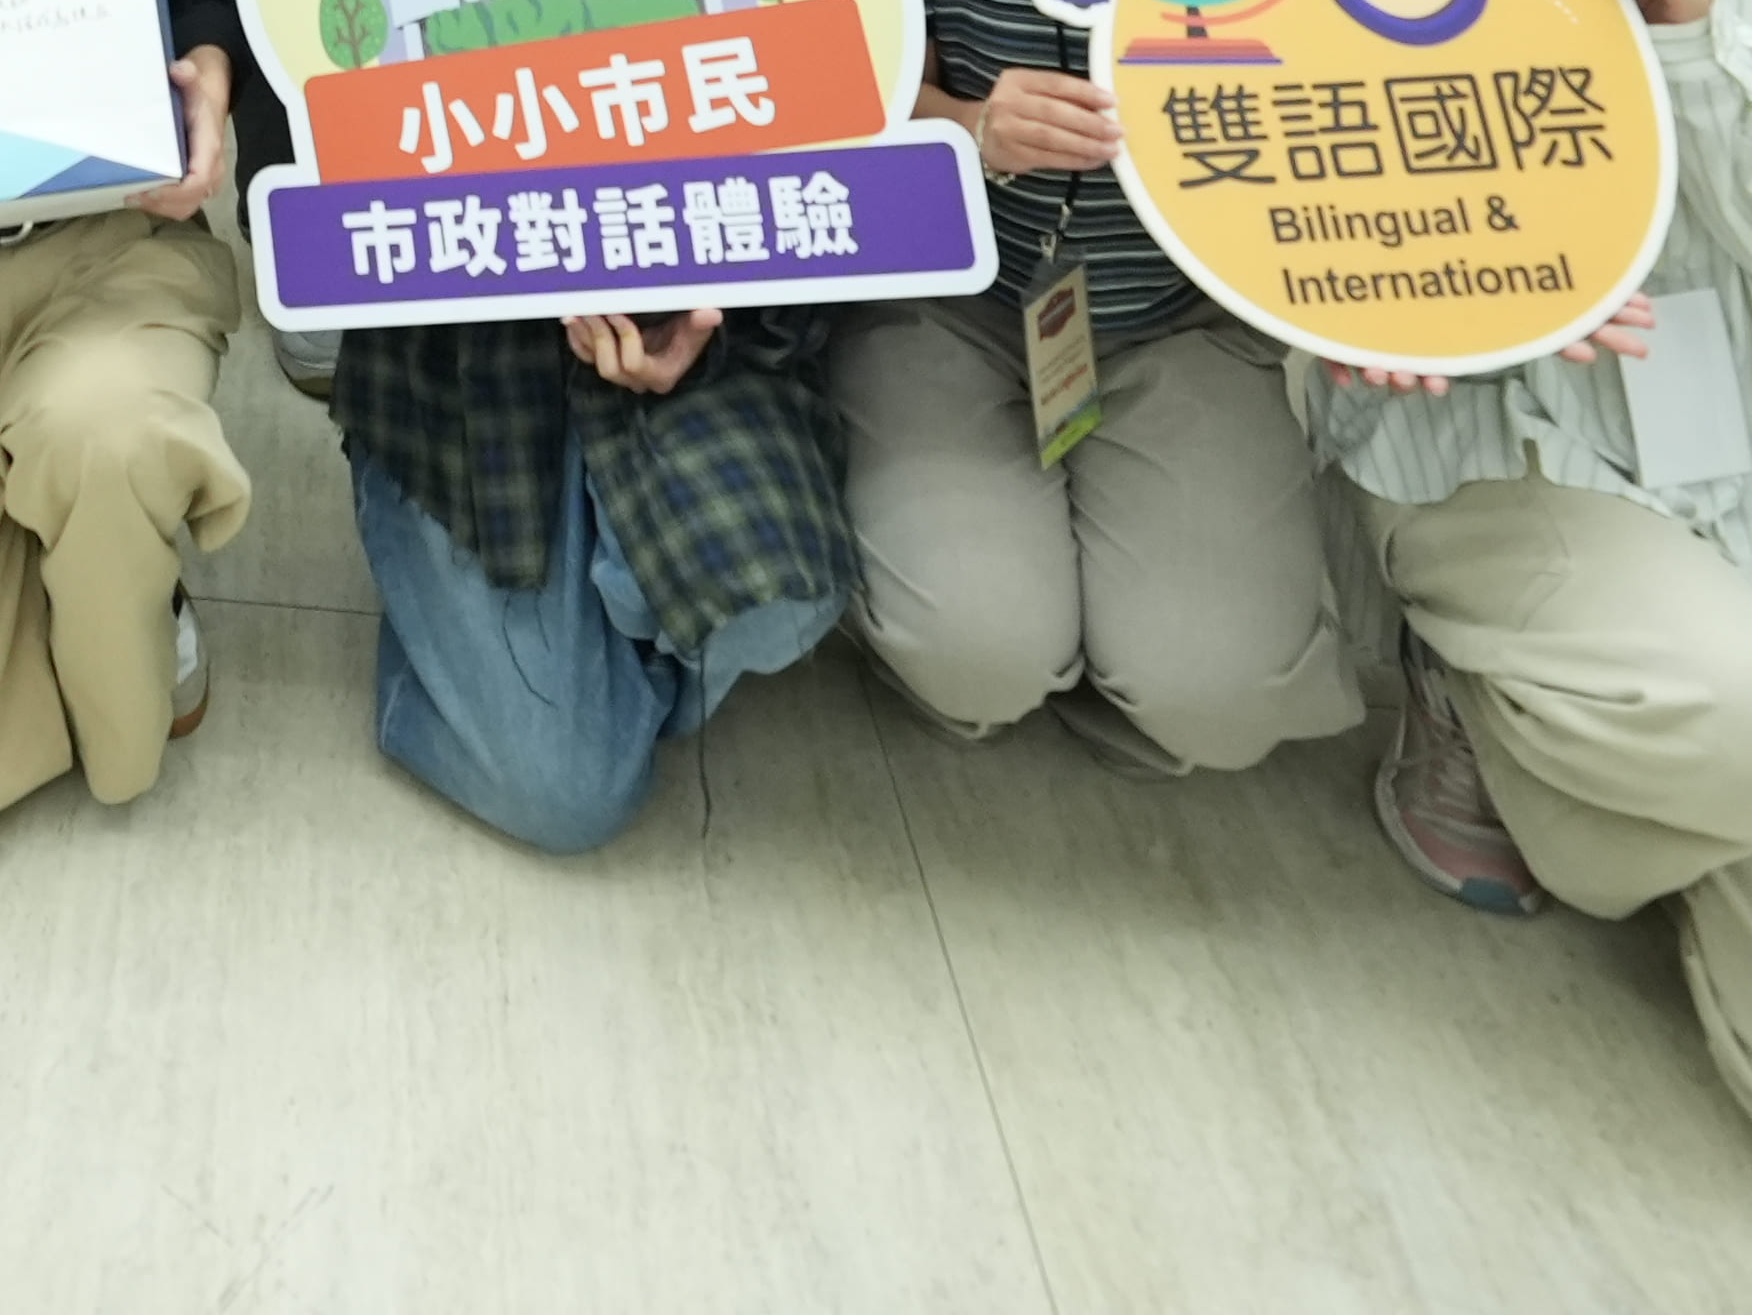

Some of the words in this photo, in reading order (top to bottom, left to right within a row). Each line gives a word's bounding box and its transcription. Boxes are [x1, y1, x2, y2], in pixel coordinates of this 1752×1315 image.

[398, 36, 777, 174] 小小市民
[1162, 64, 1615, 190] 雙語國際
[341, 170, 859, 285] 市政對話體驗
[1268, 197, 1473, 249] Bilingual
[1485, 195, 1520, 233] &
[1284, 254, 1575, 306] International
